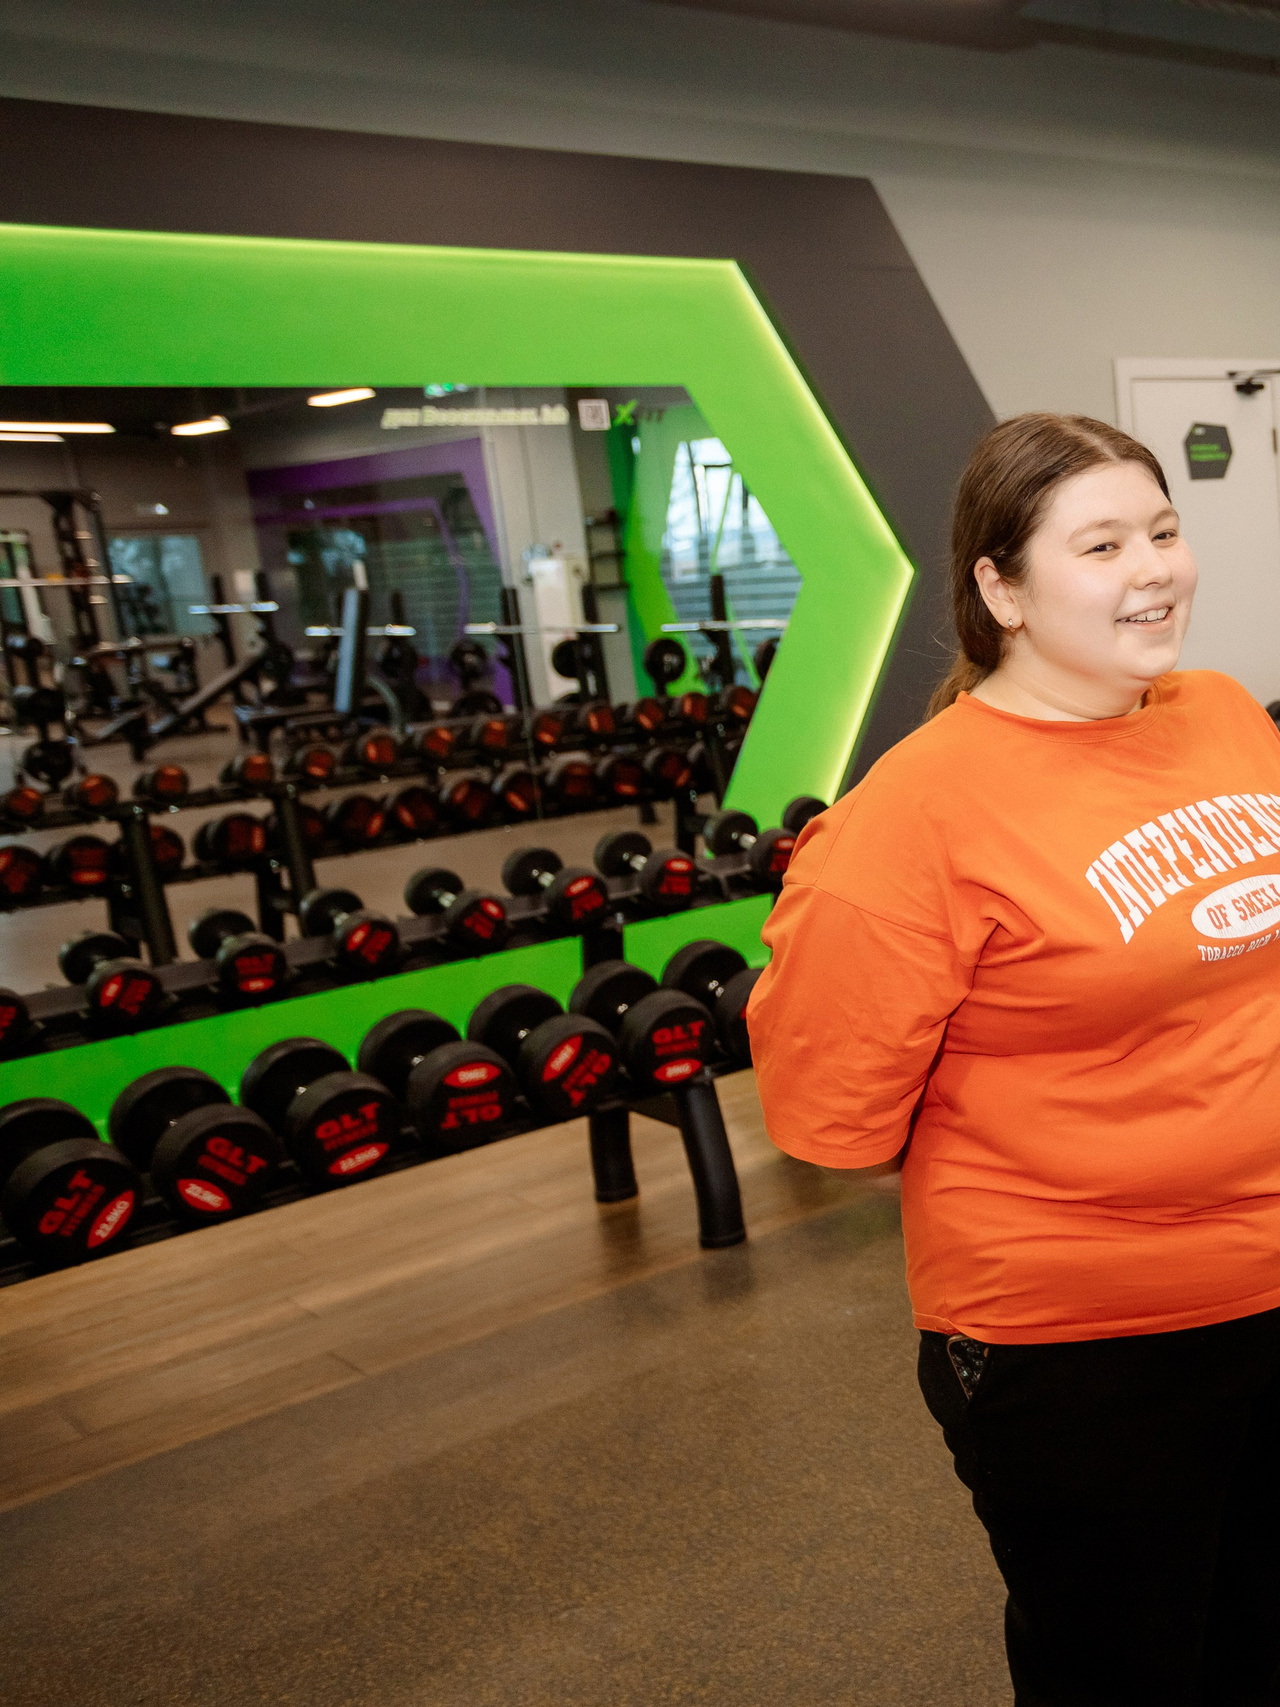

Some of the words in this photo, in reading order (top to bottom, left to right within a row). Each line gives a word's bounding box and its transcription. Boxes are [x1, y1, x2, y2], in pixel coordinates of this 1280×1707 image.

[1206, 904, 1231, 930] OF
[1197, 944, 1244, 962] TOBACCO
[1245, 933, 1271, 952] RICH
[315, 1101, 380, 1140] GLT
[440, 1103, 502, 1131] GLT
[205, 1136, 267, 1175] GLT
[38, 1169, 93, 1235] GLT
